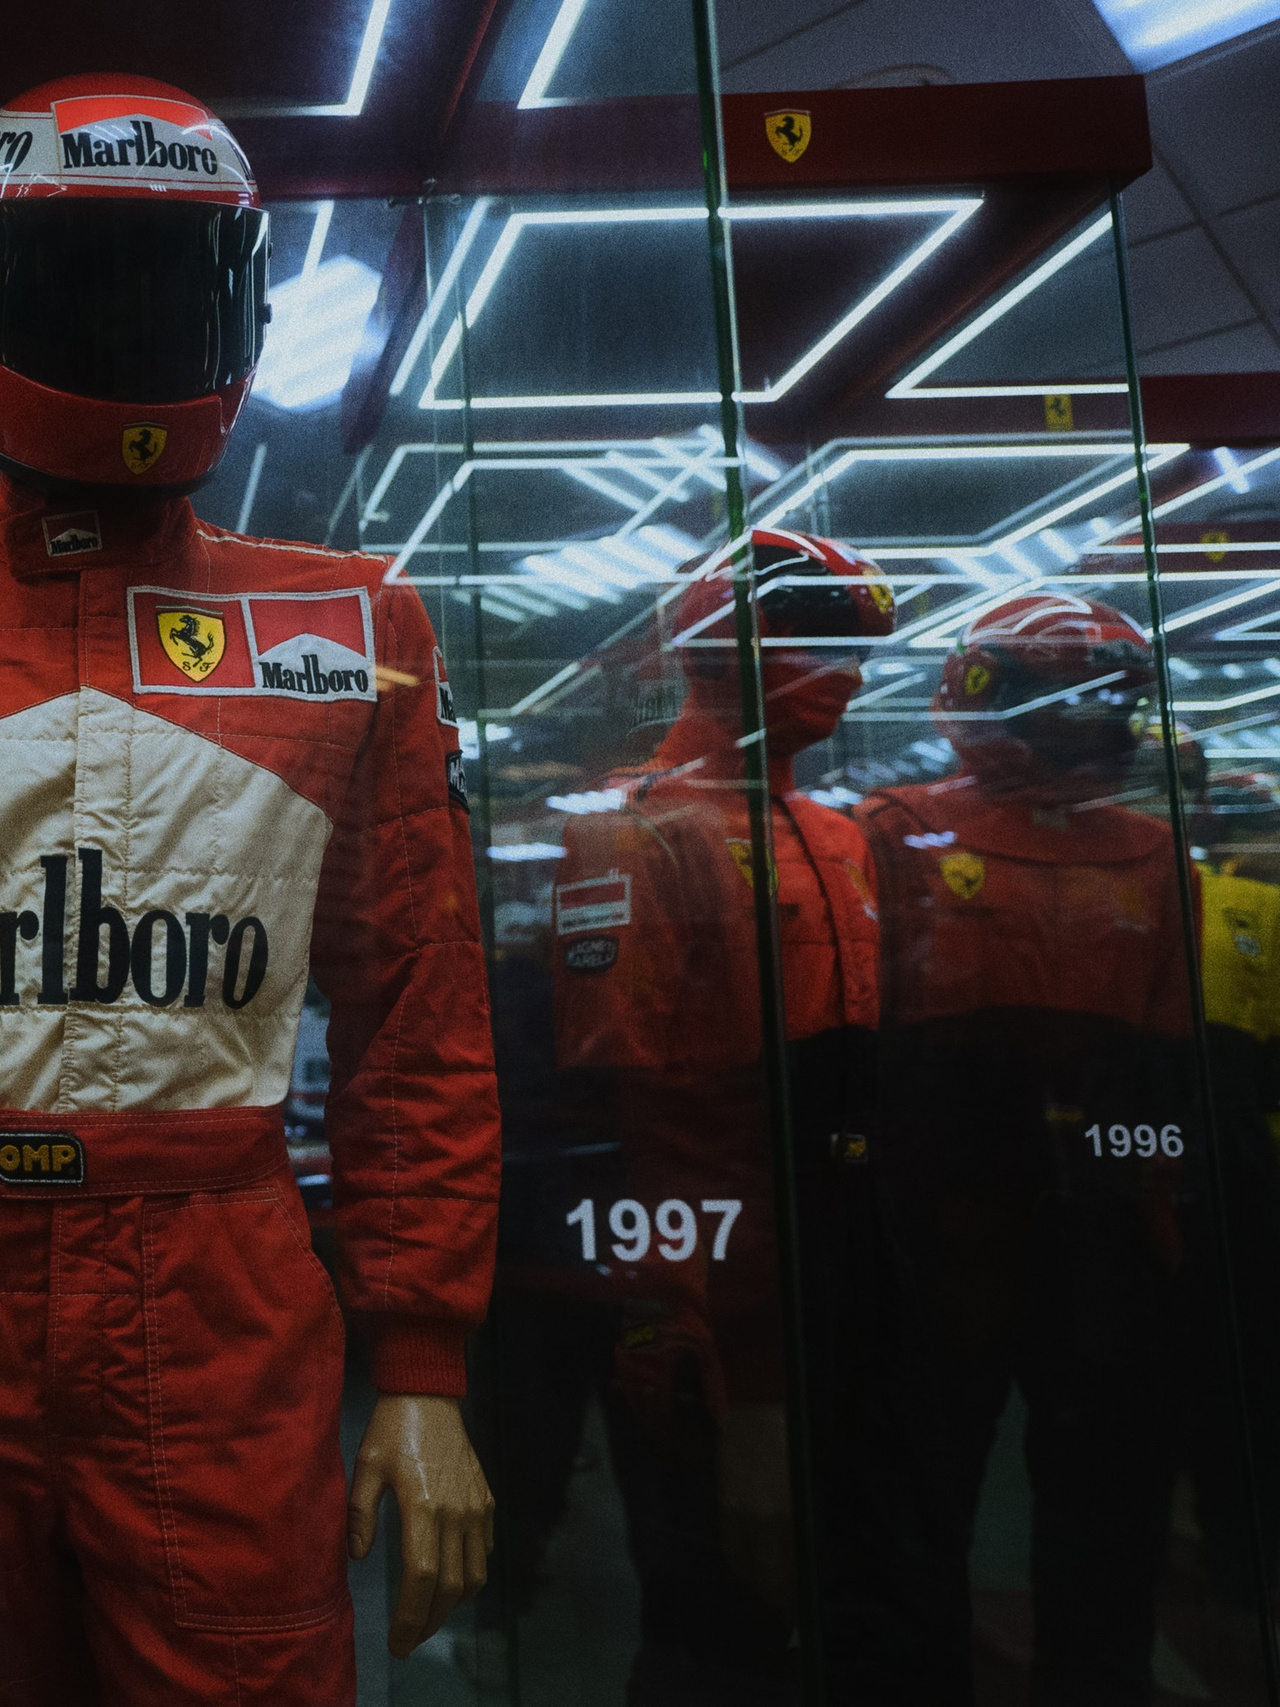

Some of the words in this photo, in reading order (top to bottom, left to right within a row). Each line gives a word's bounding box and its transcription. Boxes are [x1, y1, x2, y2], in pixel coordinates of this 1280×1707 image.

[60, 120, 218, 175] Marlboro
[50, 533, 98, 554] Marlboro
[259, 654, 369, 694] Marlboro
[1083, 1123, 1185, 1158] 1996
[566, 1198, 743, 1262] 1997
